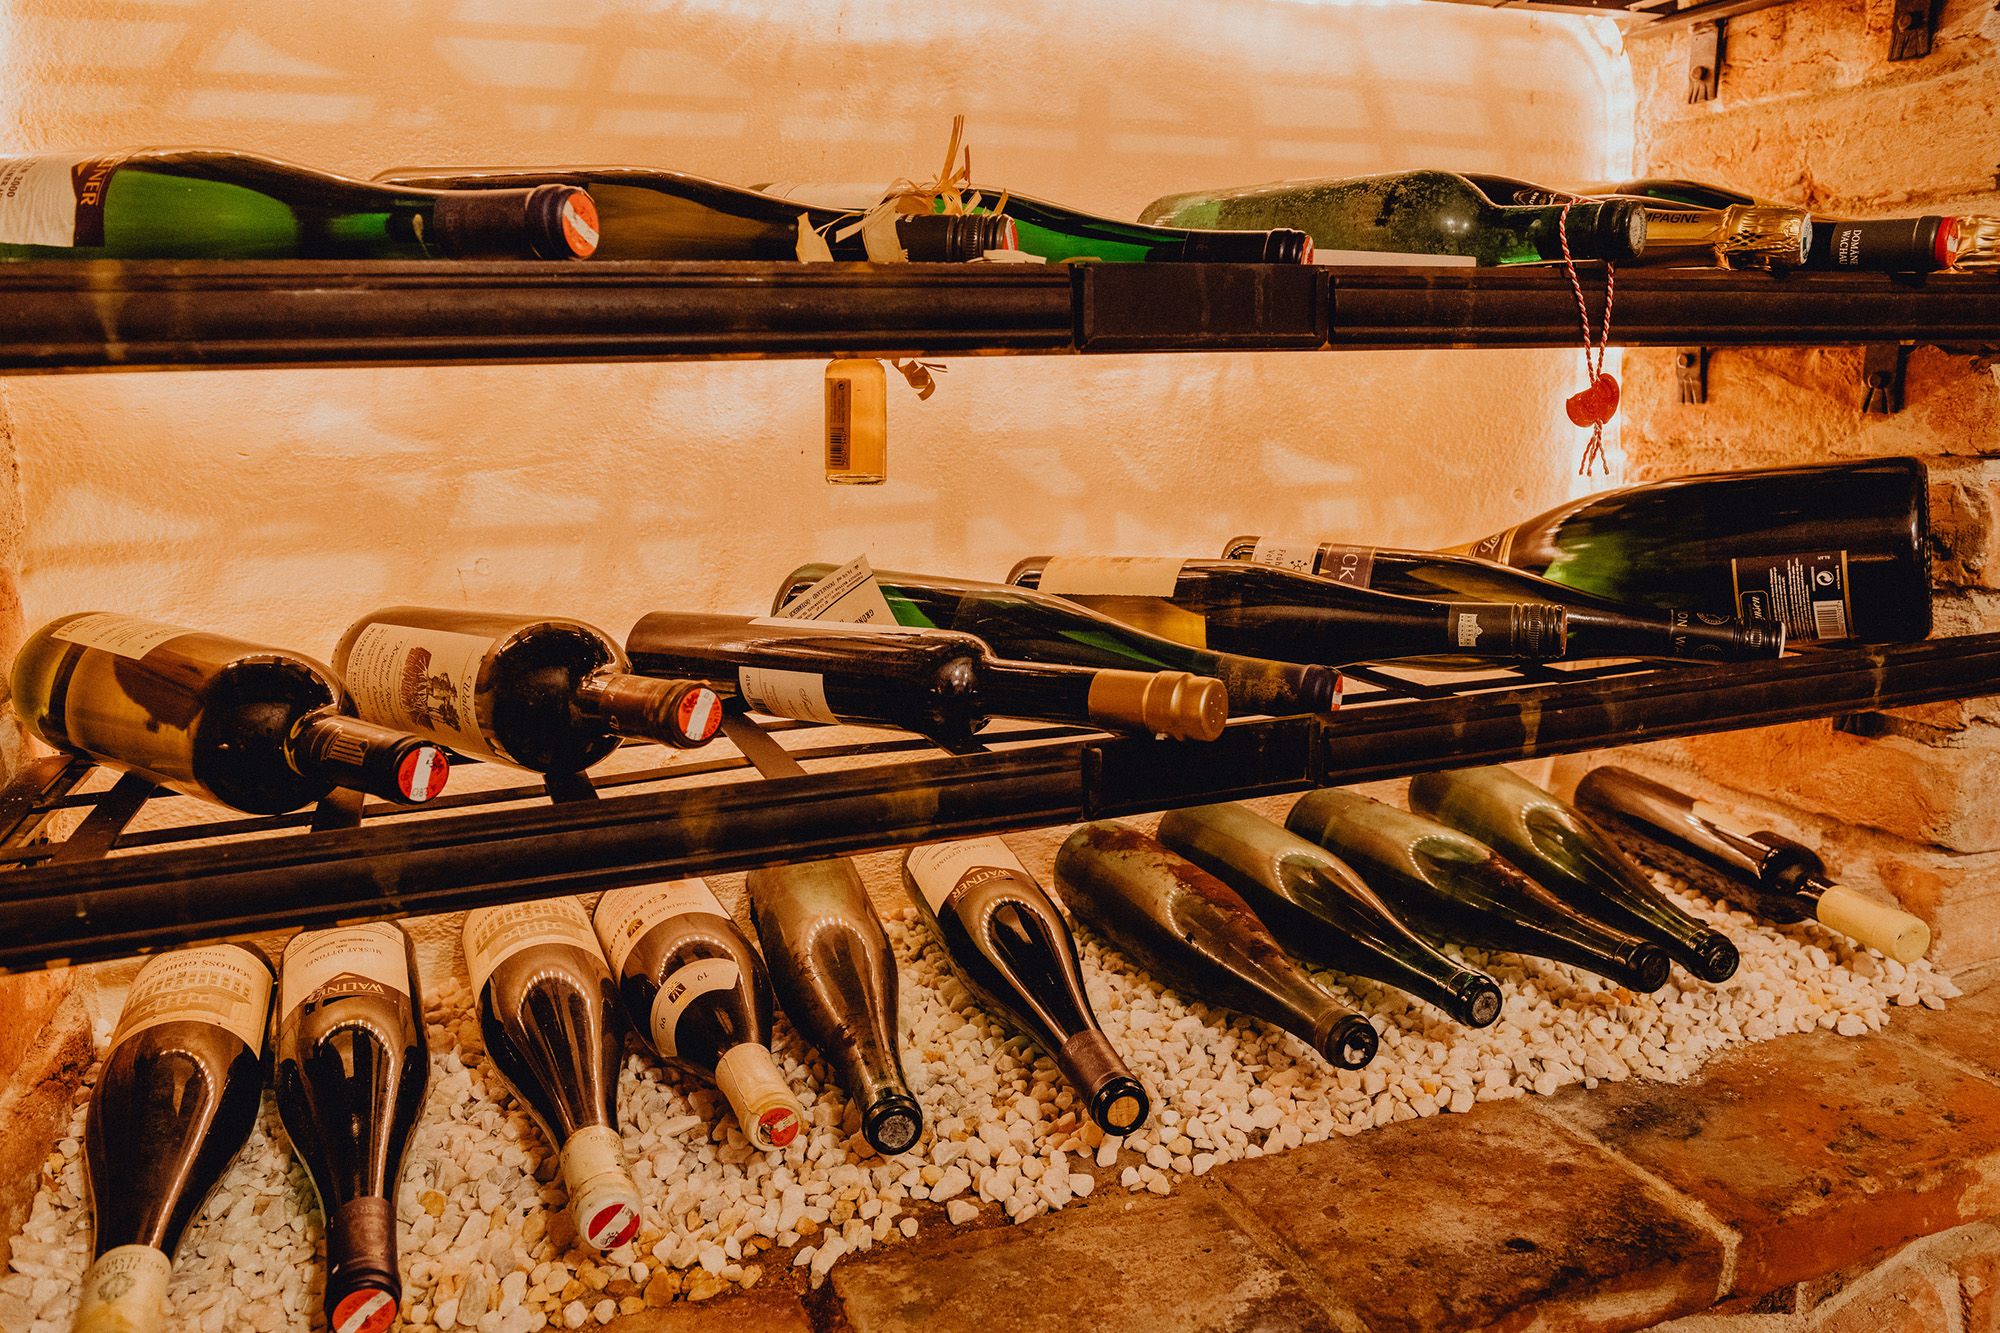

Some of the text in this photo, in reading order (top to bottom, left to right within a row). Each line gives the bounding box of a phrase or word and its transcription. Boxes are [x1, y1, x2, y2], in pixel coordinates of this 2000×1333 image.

[1646, 213, 1701, 223] MPAGNE
[1839, 230, 1852, 265] WACHAU
[1849, 229, 1862, 265] DOMÄNE
[1275, 549, 1287, 566] Früh
[854, 608, 875, 624] GRÜN
[1676, 612, 1689, 627] ON
[951, 868, 1012, 900] WALTNER
[305, 949, 344, 968] OTTONEL
[347, 947, 382, 956] MUSKAT
[202, 960, 252, 980] SCHLOSS
[318, 982, 385, 998] WALTN
